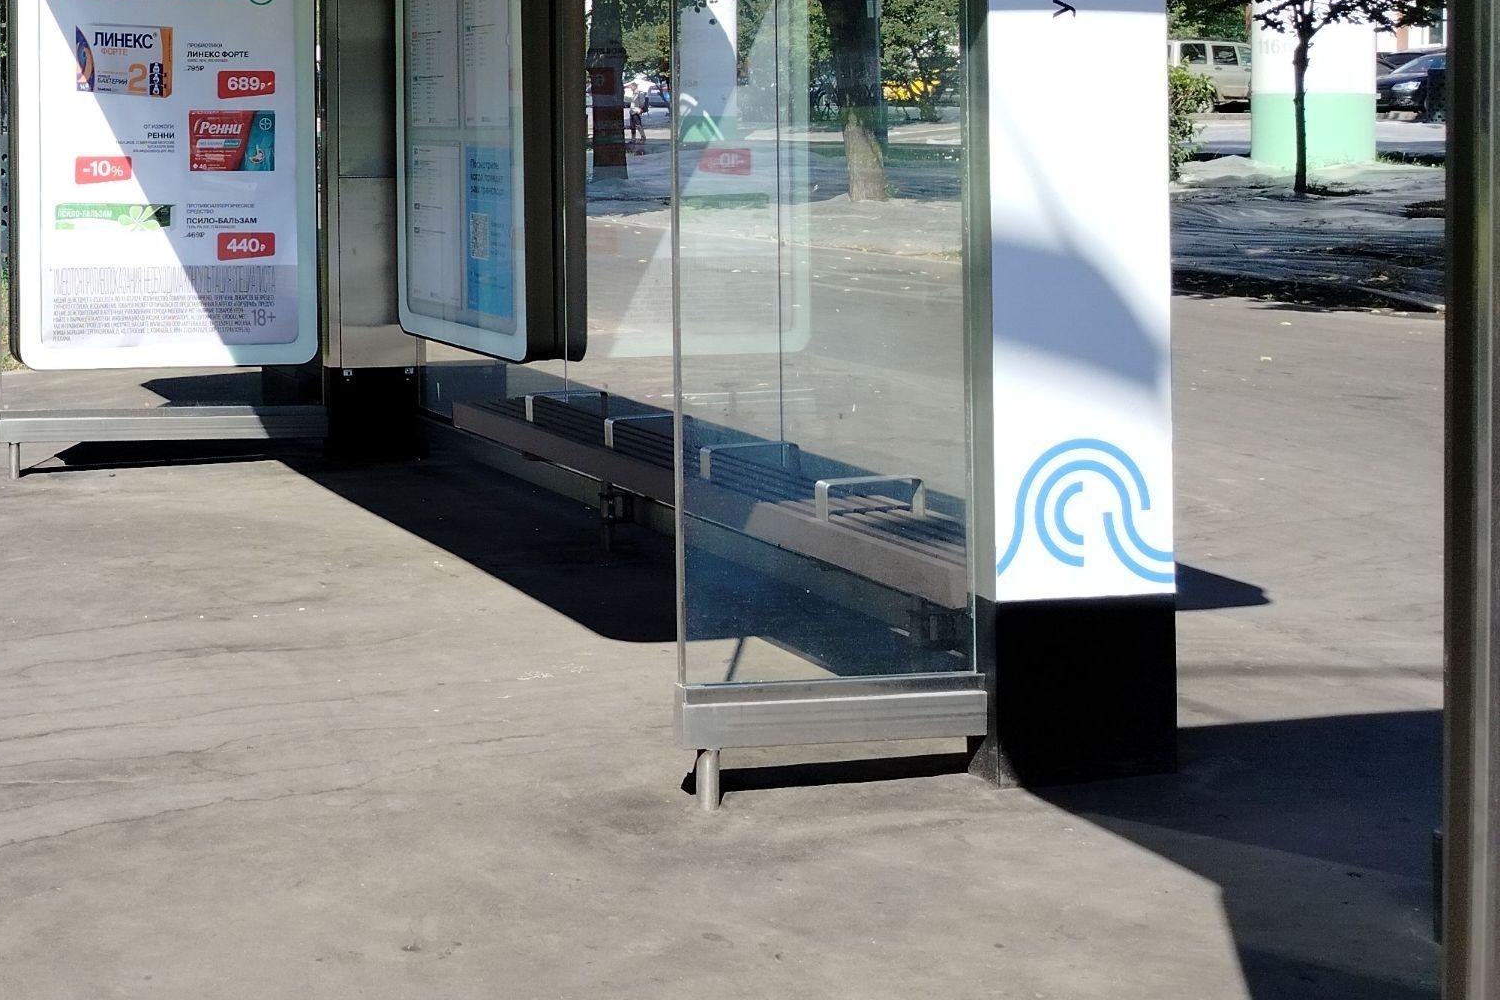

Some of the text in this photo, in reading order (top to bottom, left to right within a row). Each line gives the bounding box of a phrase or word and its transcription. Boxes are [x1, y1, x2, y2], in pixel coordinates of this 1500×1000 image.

[100, 48, 128, 56] ФОРТЕ
[222, 50, 249, 58] ФОРТЕ
[127, 63, 148, 92] 2
[199, 121, 243, 135] Ренни
[83, 160, 124, 177] -10%
[251, 308, 276, 327] 18+
